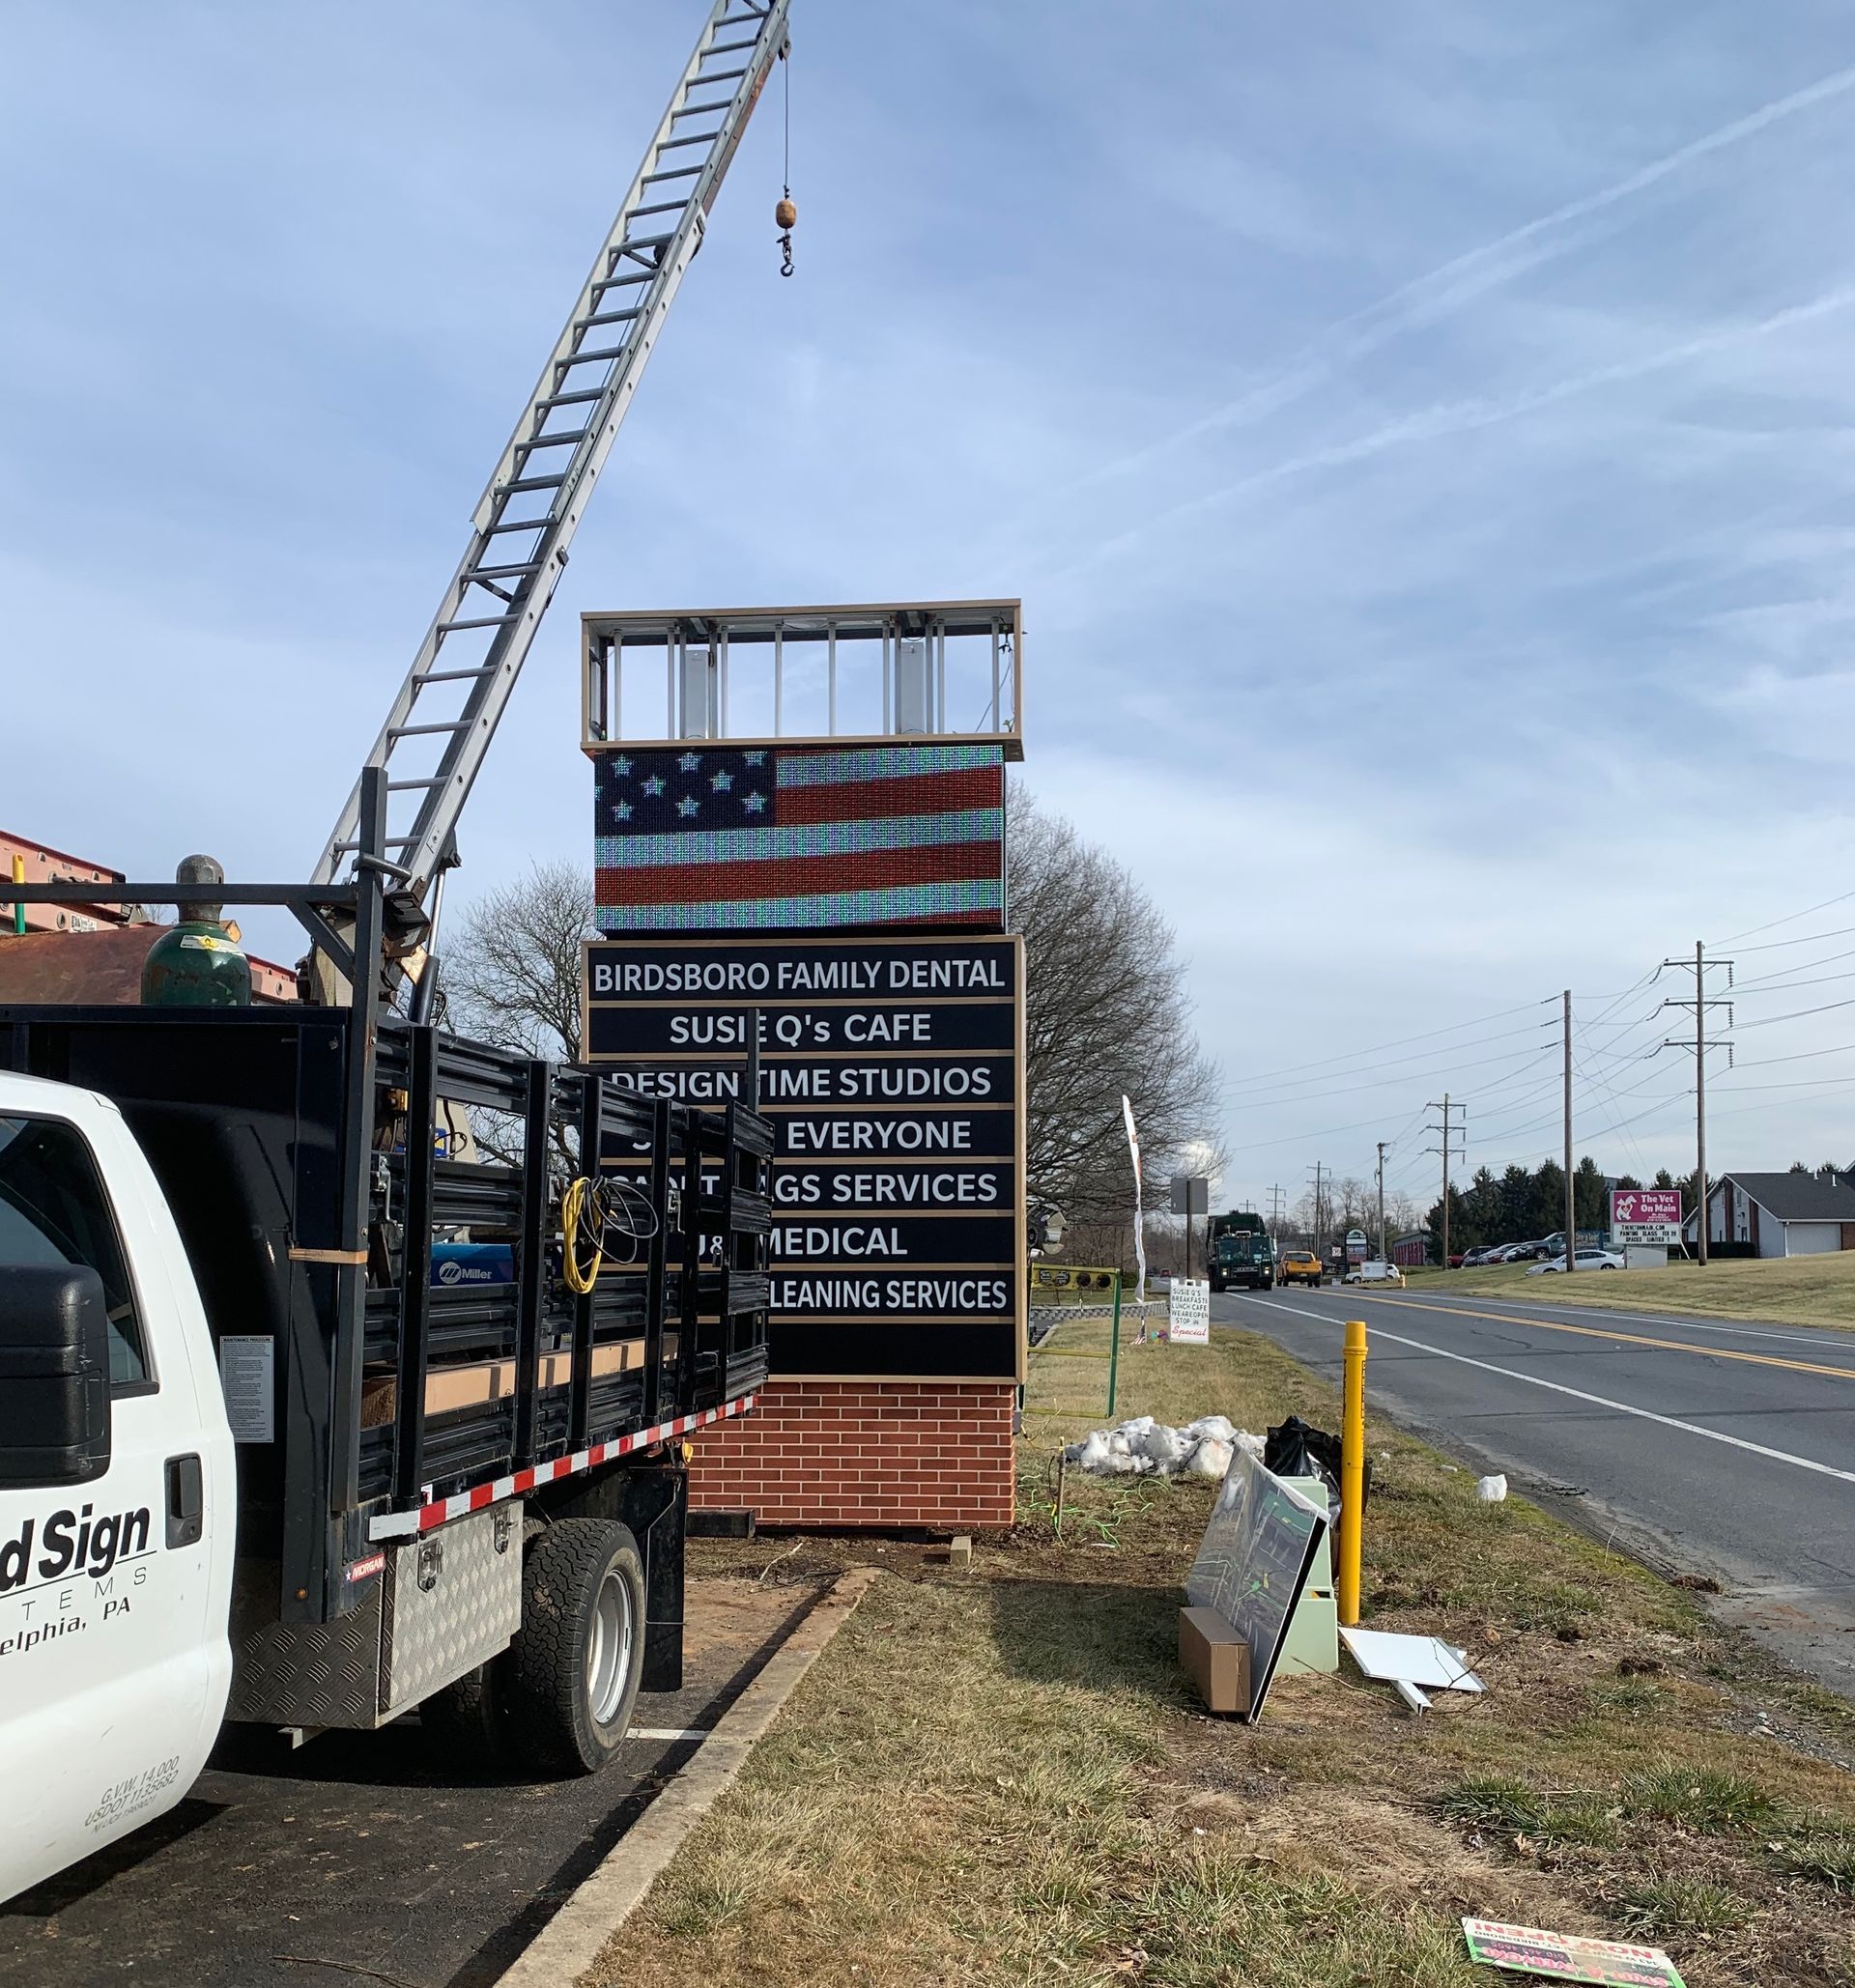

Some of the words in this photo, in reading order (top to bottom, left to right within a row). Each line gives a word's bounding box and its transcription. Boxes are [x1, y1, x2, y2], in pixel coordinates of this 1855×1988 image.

[595, 963, 770, 991] BIRDSBORO
[778, 961, 882, 990] FAMILY
[890, 959, 1005, 988] DENTAL
[776, 1014, 831, 1047] Q's
[844, 1013, 931, 1042] CAFE
[758, 1068, 831, 1096] TIME
[839, 1067, 991, 1095] STUDIOS
[787, 1121, 972, 1150] EVERYONE
[832, 1174, 997, 1202] SERVICES
[1641, 1194, 1658, 1204] The
[1659, 1194, 1673, 1204] Vet
[1641, 1204, 1654, 1212] On
[1655, 1204, 1676, 1212] Main
[462, 1268, 493, 1280] Miller
[770, 1280, 879, 1308] LEANING
[886, 1280, 1007, 1309] SERVICES
[1172, 1325, 1207, 1337] Special
[38, 1502, 151, 1579] Sign
[352, 1555, 385, 1579] MORGAN
[0, 1616, 87, 1656] elphia,
[103, 1597, 131, 1621] PA
[84, 1793, 130, 1827] USDOT
[1577, 1941, 1654, 1959] NOW
